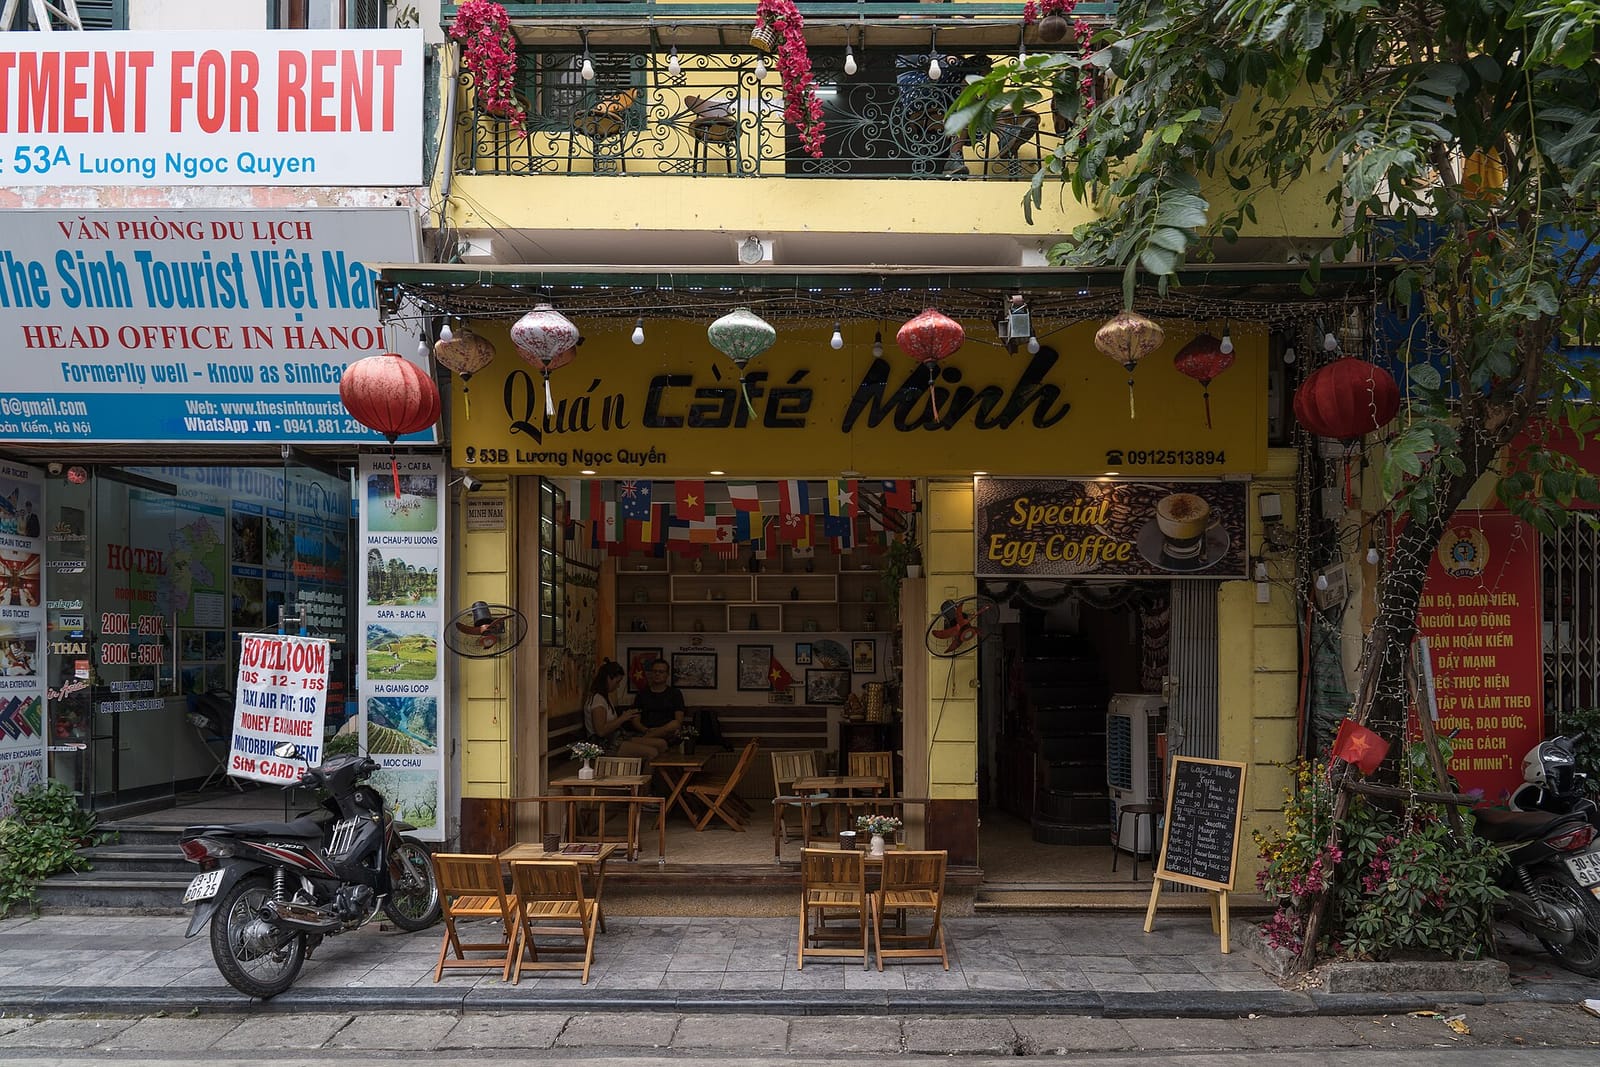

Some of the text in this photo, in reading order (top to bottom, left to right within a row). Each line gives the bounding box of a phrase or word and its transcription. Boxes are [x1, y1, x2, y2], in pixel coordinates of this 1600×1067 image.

[170, 50, 259, 134] FOR
[278, 49, 402, 132] RENT
[13, 145, 71, 174] 53A
[79, 152, 156, 178] Luong
[165, 152, 228, 178] Ngoc
[236, 152, 316, 178] Quyen
[58, 216, 313, 244] VĂN PHÒNG DU LỊCH
[55, 249, 133, 309] Sinh
[134, 249, 248, 309] Tourist
[250, 249, 318, 321] Việt
[21, 326, 387, 350] HEAD OFFICE IN HANOI
[62, 362, 146, 384] Formerlly
[151, 362, 189, 383] well
[207, 362, 254, 383] Know
[259, 366, 280, 383] as
[504, 369, 630, 445] Quán
[842, 345, 1070, 433] Minh
[186, 400, 218, 415] Web:
[54, 421, 70, 433] Hà
[72, 421, 92, 436] Nội
[184, 417, 248, 433] WhatsApp
[479, 449, 508, 463] 53B
[516, 449, 568, 466] Lương
[573, 449, 613, 467] Ngọc
[1127, 450, 1226, 465] 0912513894
[14, 467, 29, 479] TICKET
[373, 462, 402, 470] HALOG
[408, 462, 421, 470] CAT
[422, 462, 431, 470] BA
[237, 469, 293, 503] TOURIST
[1010, 497, 1112, 527] Special
[15, 539, 32, 549] TICKET
[368, 536, 381, 544] MAI
[414, 536, 437, 545] LUONG
[988, 533, 1132, 567] Egg Coffee
[107, 544, 167, 576] HOTEL
[2, 609, 30, 619] BUS TICKET
[64, 618, 81, 626] VISA
[377, 610, 394, 619] SAPA
[400, 610, 414, 619] BAC
[415, 610, 426, 619] HA
[1458, 615, 1478, 627] LAO
[102, 613, 130, 634] 200K
[138, 615, 164, 635] 250K
[51, 642, 87, 654] THAI
[102, 644, 130, 665] 300K
[138, 644, 164, 665] 350K
[1463, 655, 1496, 671] MẠNH
[10, 680, 37, 689] EXTENTION
[242, 670, 259, 684] 10$
[270, 675, 288, 686] 12
[301, 678, 324, 691] 15$
[374, 685, 429, 693] HA GIANG LOOP
[242, 689, 257, 707] TAXI
[259, 692, 277, 709] AIR
[299, 696, 316, 714] 10$
[1504, 696, 1531, 708] THEO
[241, 712, 271, 732] MONEY
[1476, 717, 1498, 732] ĐẠO
[13, 748, 42, 759] EXCHANGE
[234, 735, 282, 757] MOTORBIK
[233, 756, 255, 773] SIM
[260, 761, 294, 779] CARD
[383, 759, 421, 767] MOC CHAU
